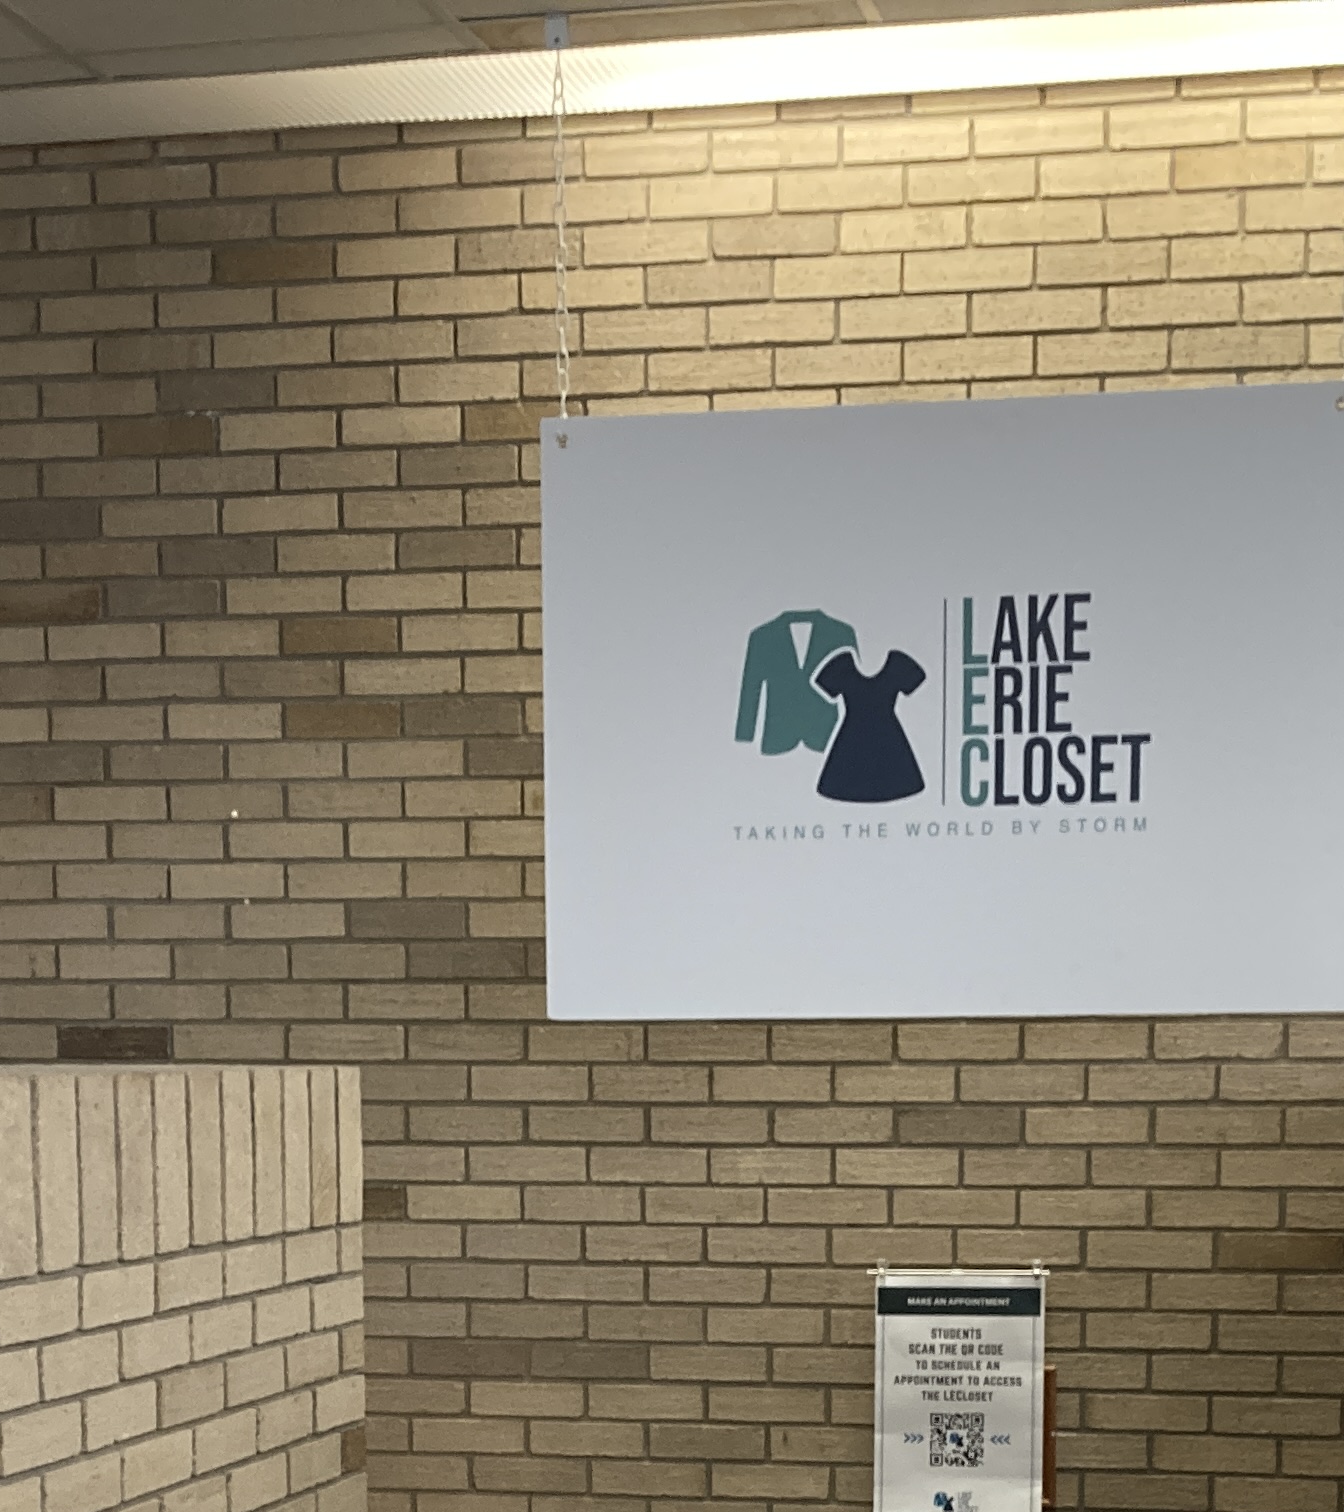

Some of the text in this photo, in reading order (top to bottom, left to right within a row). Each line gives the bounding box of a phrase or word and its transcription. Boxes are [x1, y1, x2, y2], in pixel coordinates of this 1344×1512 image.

[962, 592, 1091, 666] LAKE
[962, 664, 1074, 735] ERIE
[960, 733, 1151, 807] CLOSET
[733, 816, 1149, 841] TAKING THE WORLD BY STORM
[907, 1297, 1011, 1307] MAKE AN APPOINTMENT
[931, 1327, 982, 1340] STUDENTS
[908, 1343, 1004, 1356] SCAN THE QR CODE
[916, 1359, 1000, 1371] TO SCHEDULE AN
[894, 1374, 1022, 1387] APPOINTMENT TO ACCESS
[921, 1390, 940, 1401] THE
